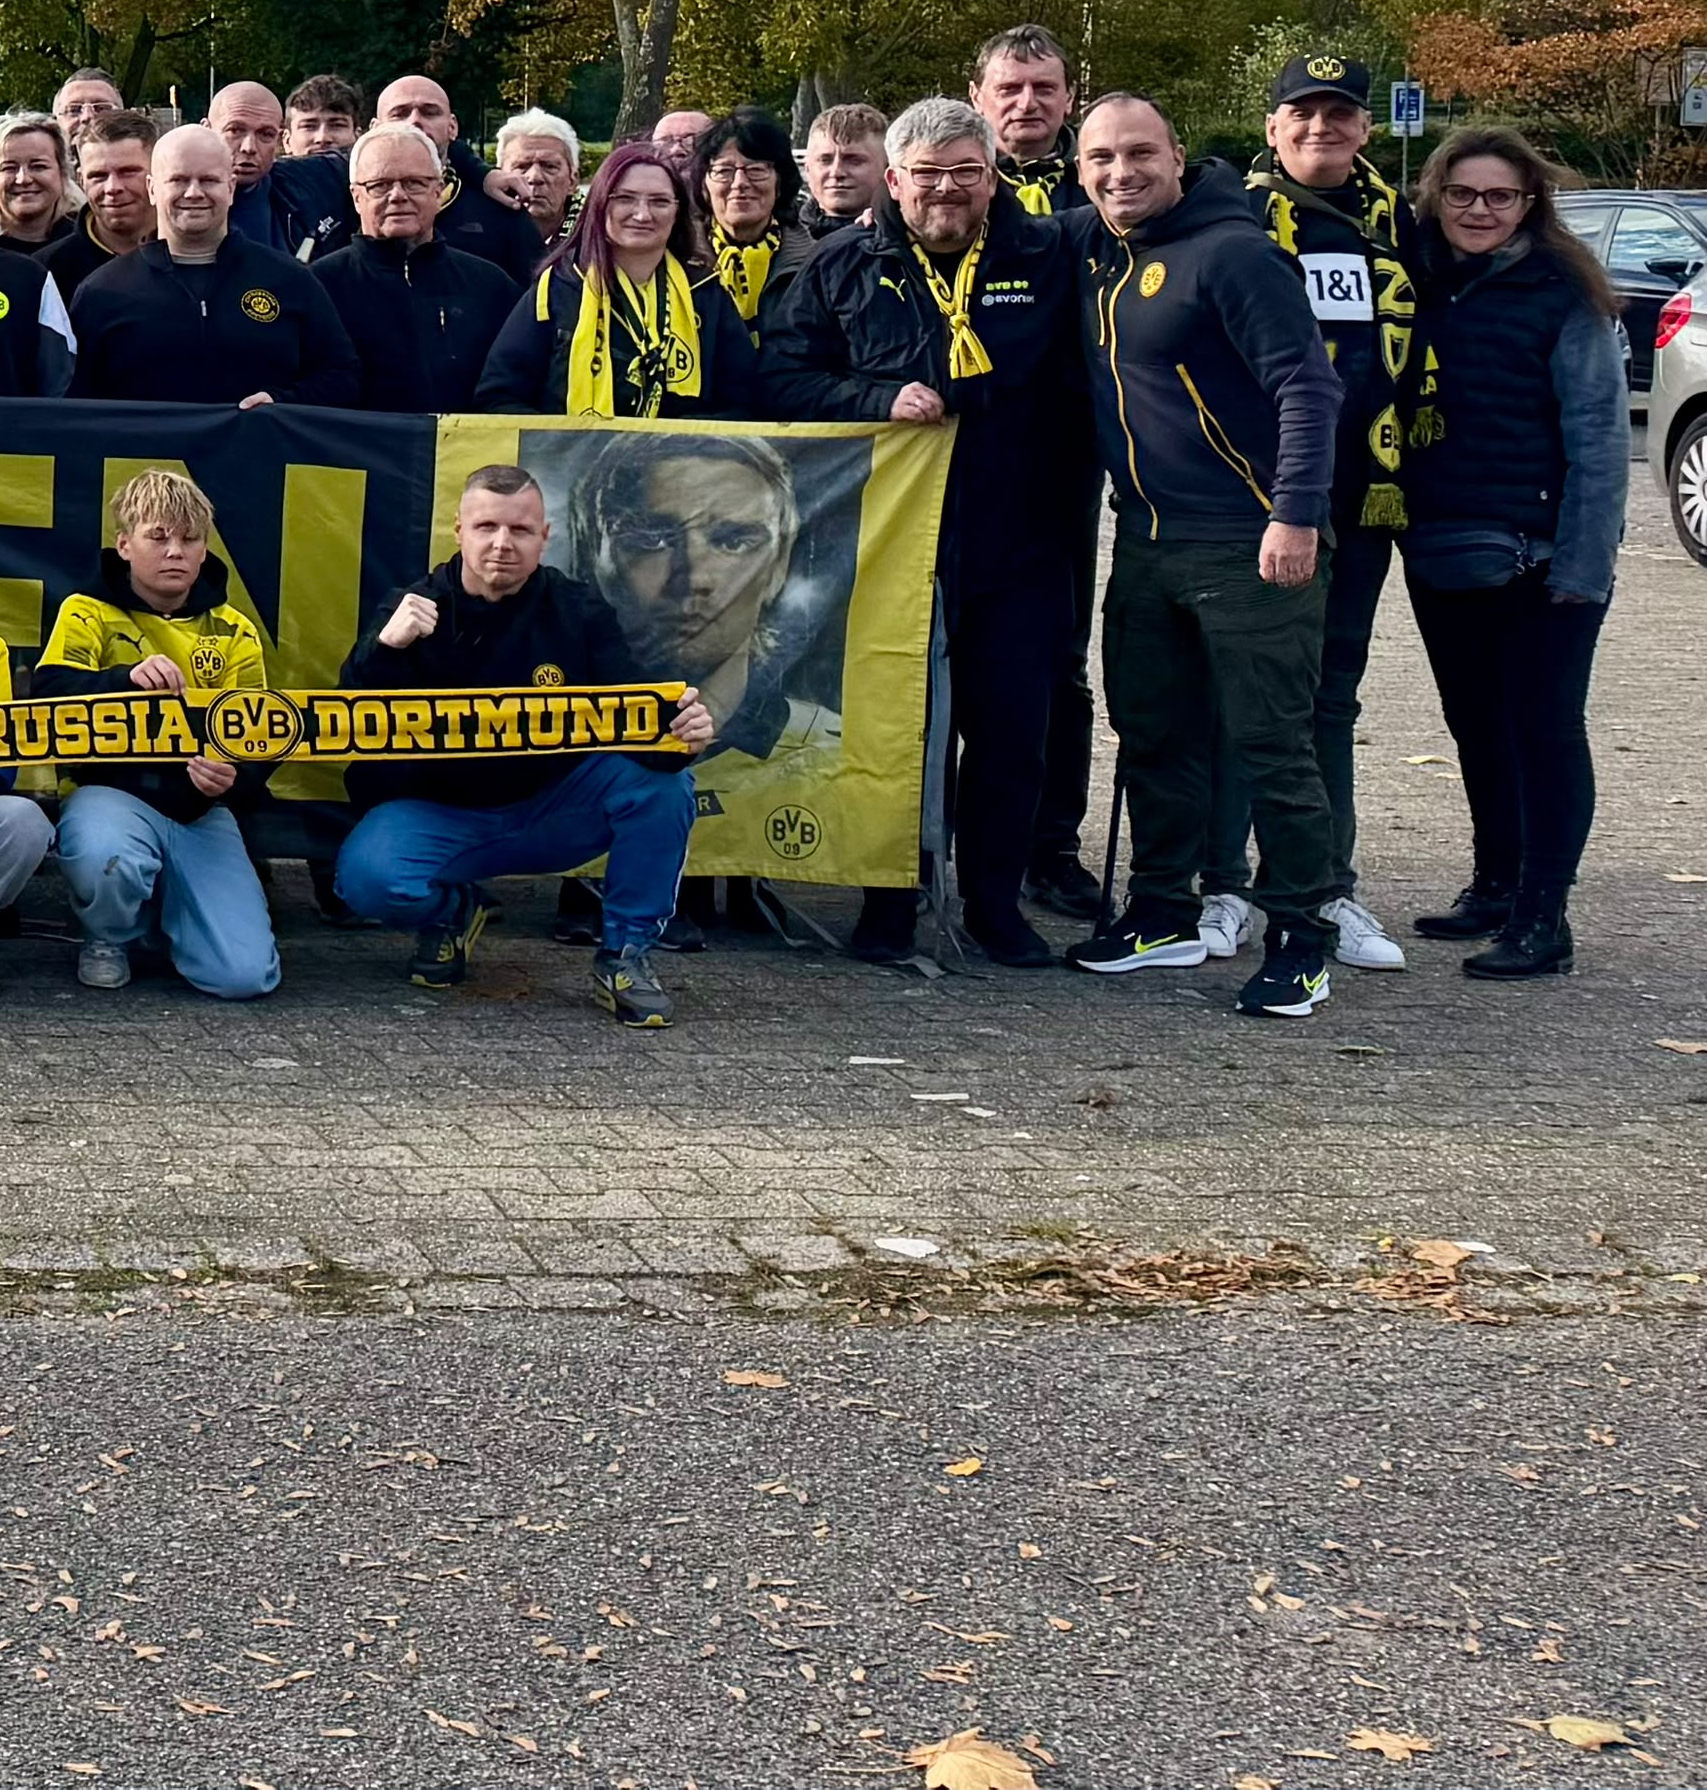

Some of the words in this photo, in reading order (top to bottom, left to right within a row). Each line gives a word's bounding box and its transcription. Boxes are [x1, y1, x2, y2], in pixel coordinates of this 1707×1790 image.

[1314, 58, 1341, 73] BVB
[1309, 268, 1366, 303] 1&1
[195, 650, 221, 670] BVB
[538, 668, 560, 685] BVB
[222, 697, 291, 739] BVB
[314, 694, 660, 750] DORTMUND
[244, 739, 268, 753] 09
[772, 809, 816, 845] BVB
